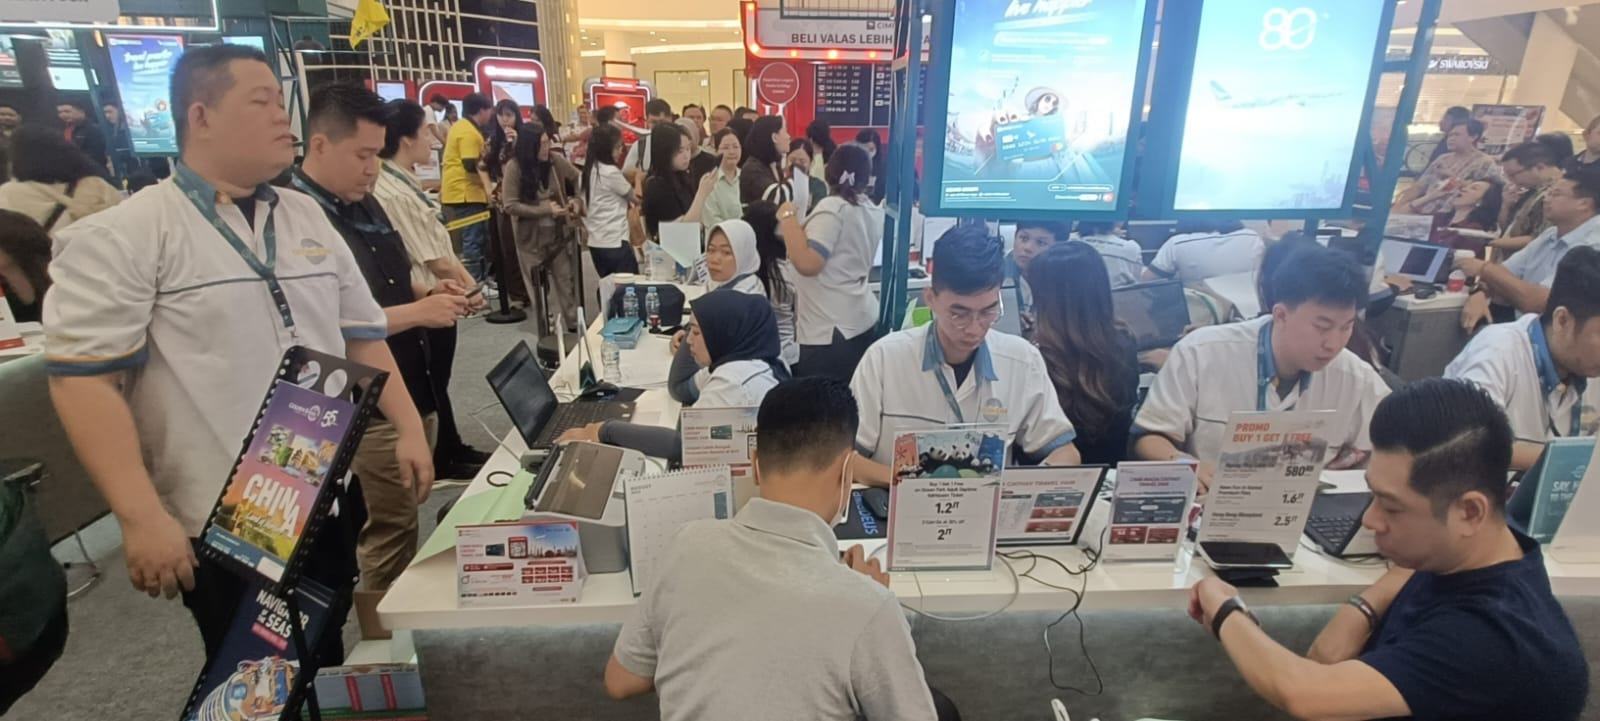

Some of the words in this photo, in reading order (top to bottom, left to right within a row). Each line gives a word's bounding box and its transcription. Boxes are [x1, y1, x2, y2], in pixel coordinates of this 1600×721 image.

[877, 22, 895, 30] CIM
[1260, 7, 1318, 51] 80
[792, 33, 817, 45] BELI
[821, 33, 857, 45] VALAS
[860, 34, 893, 45] LEBIH
[1439, 58, 1489, 70] SWAROVSKI
[1235, 423, 1270, 432] PROMO
[1232, 433, 1253, 442] BUY
[1256, 434, 1261, 442] 1
[1263, 433, 1281, 442] GET
[1290, 433, 1313, 442] FREE
[243, 473, 300, 537] CHINA
[265, 613, 293, 639] SEAS
